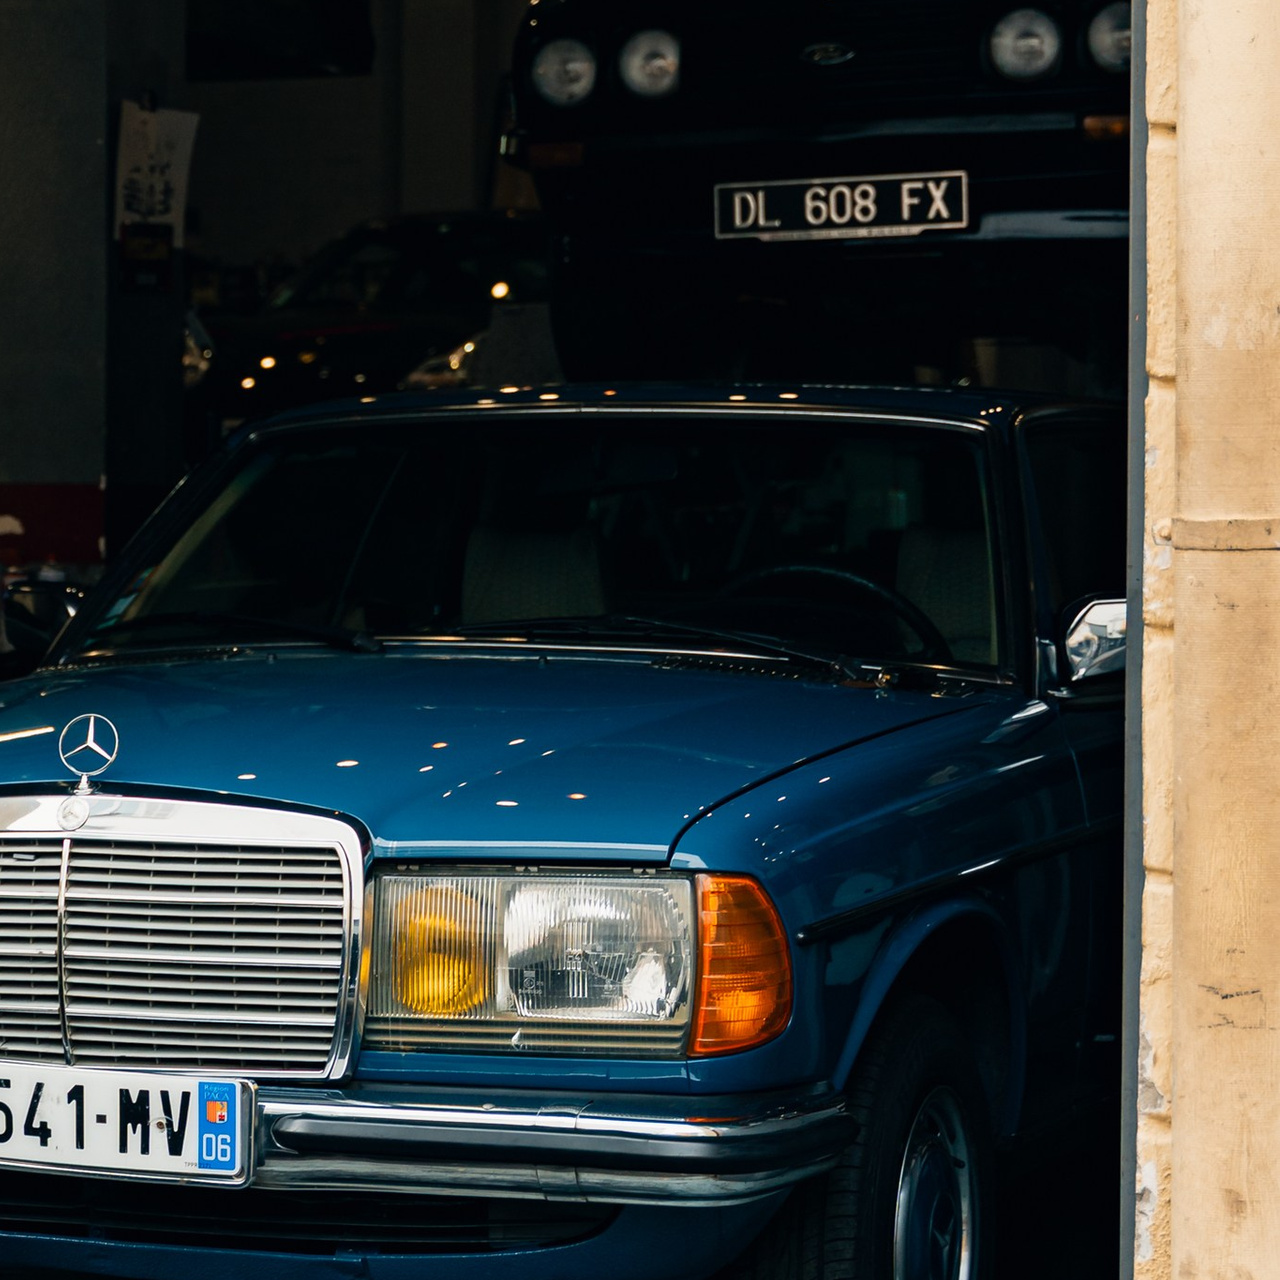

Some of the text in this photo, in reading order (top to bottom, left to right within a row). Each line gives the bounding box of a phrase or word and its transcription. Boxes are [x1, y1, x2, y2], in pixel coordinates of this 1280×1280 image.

[733, 180, 950, 229] DL 608 FX
[203, 1091, 231, 1101] PACA
[202, 1133, 231, 1162] 06
